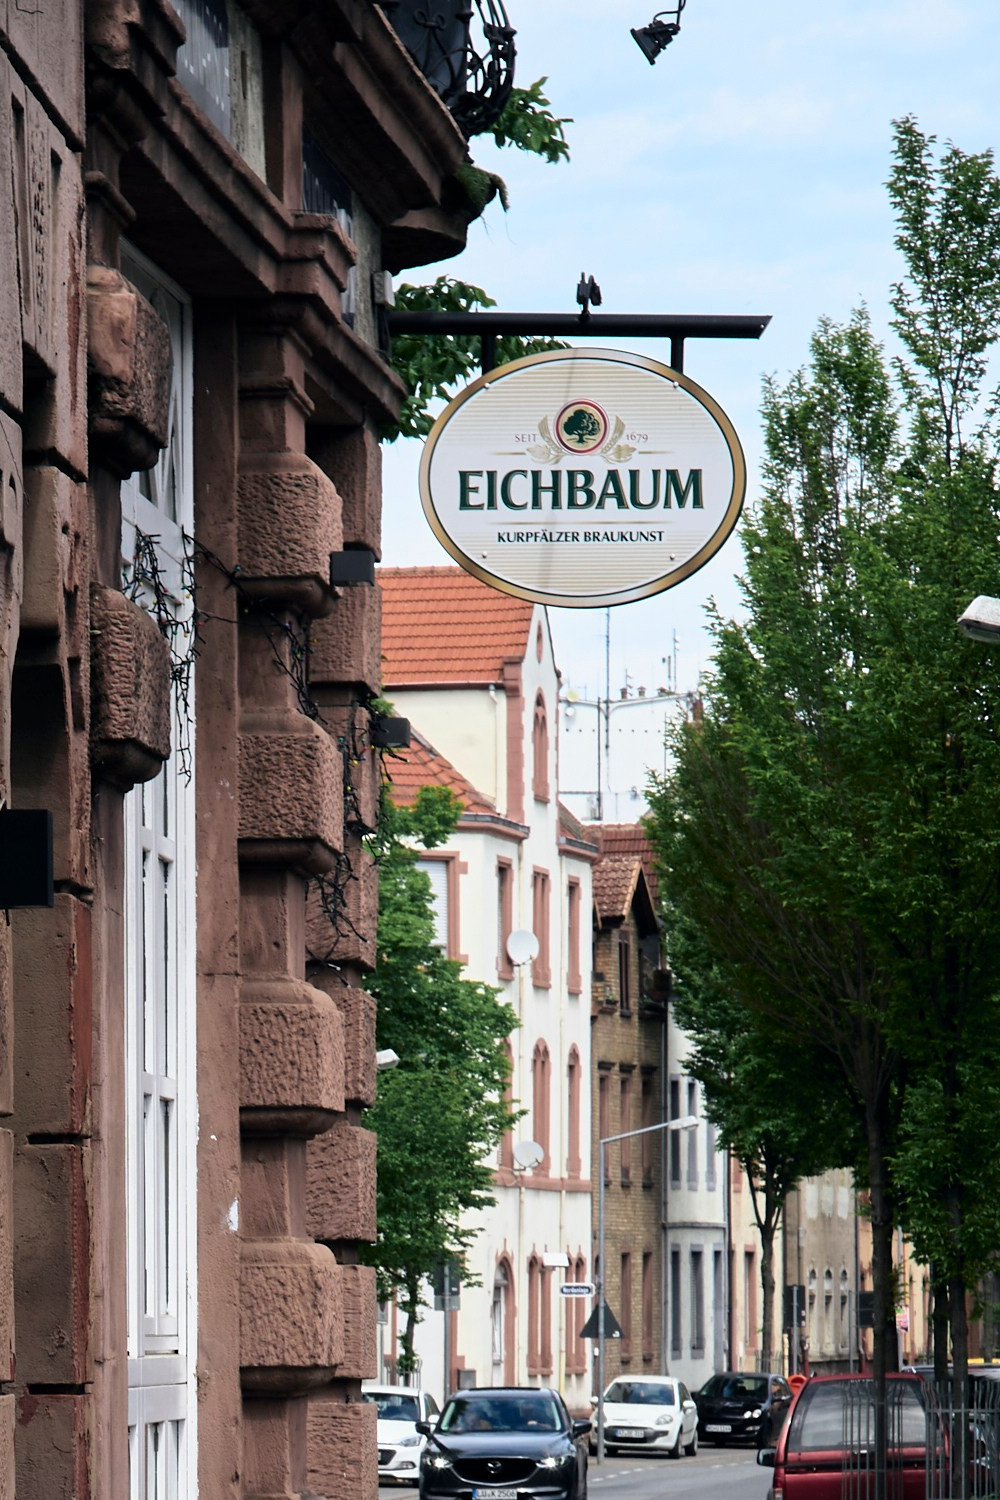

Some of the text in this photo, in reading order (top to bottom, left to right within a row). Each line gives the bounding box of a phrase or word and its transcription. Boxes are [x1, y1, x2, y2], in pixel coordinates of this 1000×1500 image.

[514, 433, 648, 443] SEIT 1679
[458, 468, 704, 511] EICHBAUM
[497, 529, 665, 543] KURPFÄLZER BRAUKUNST
